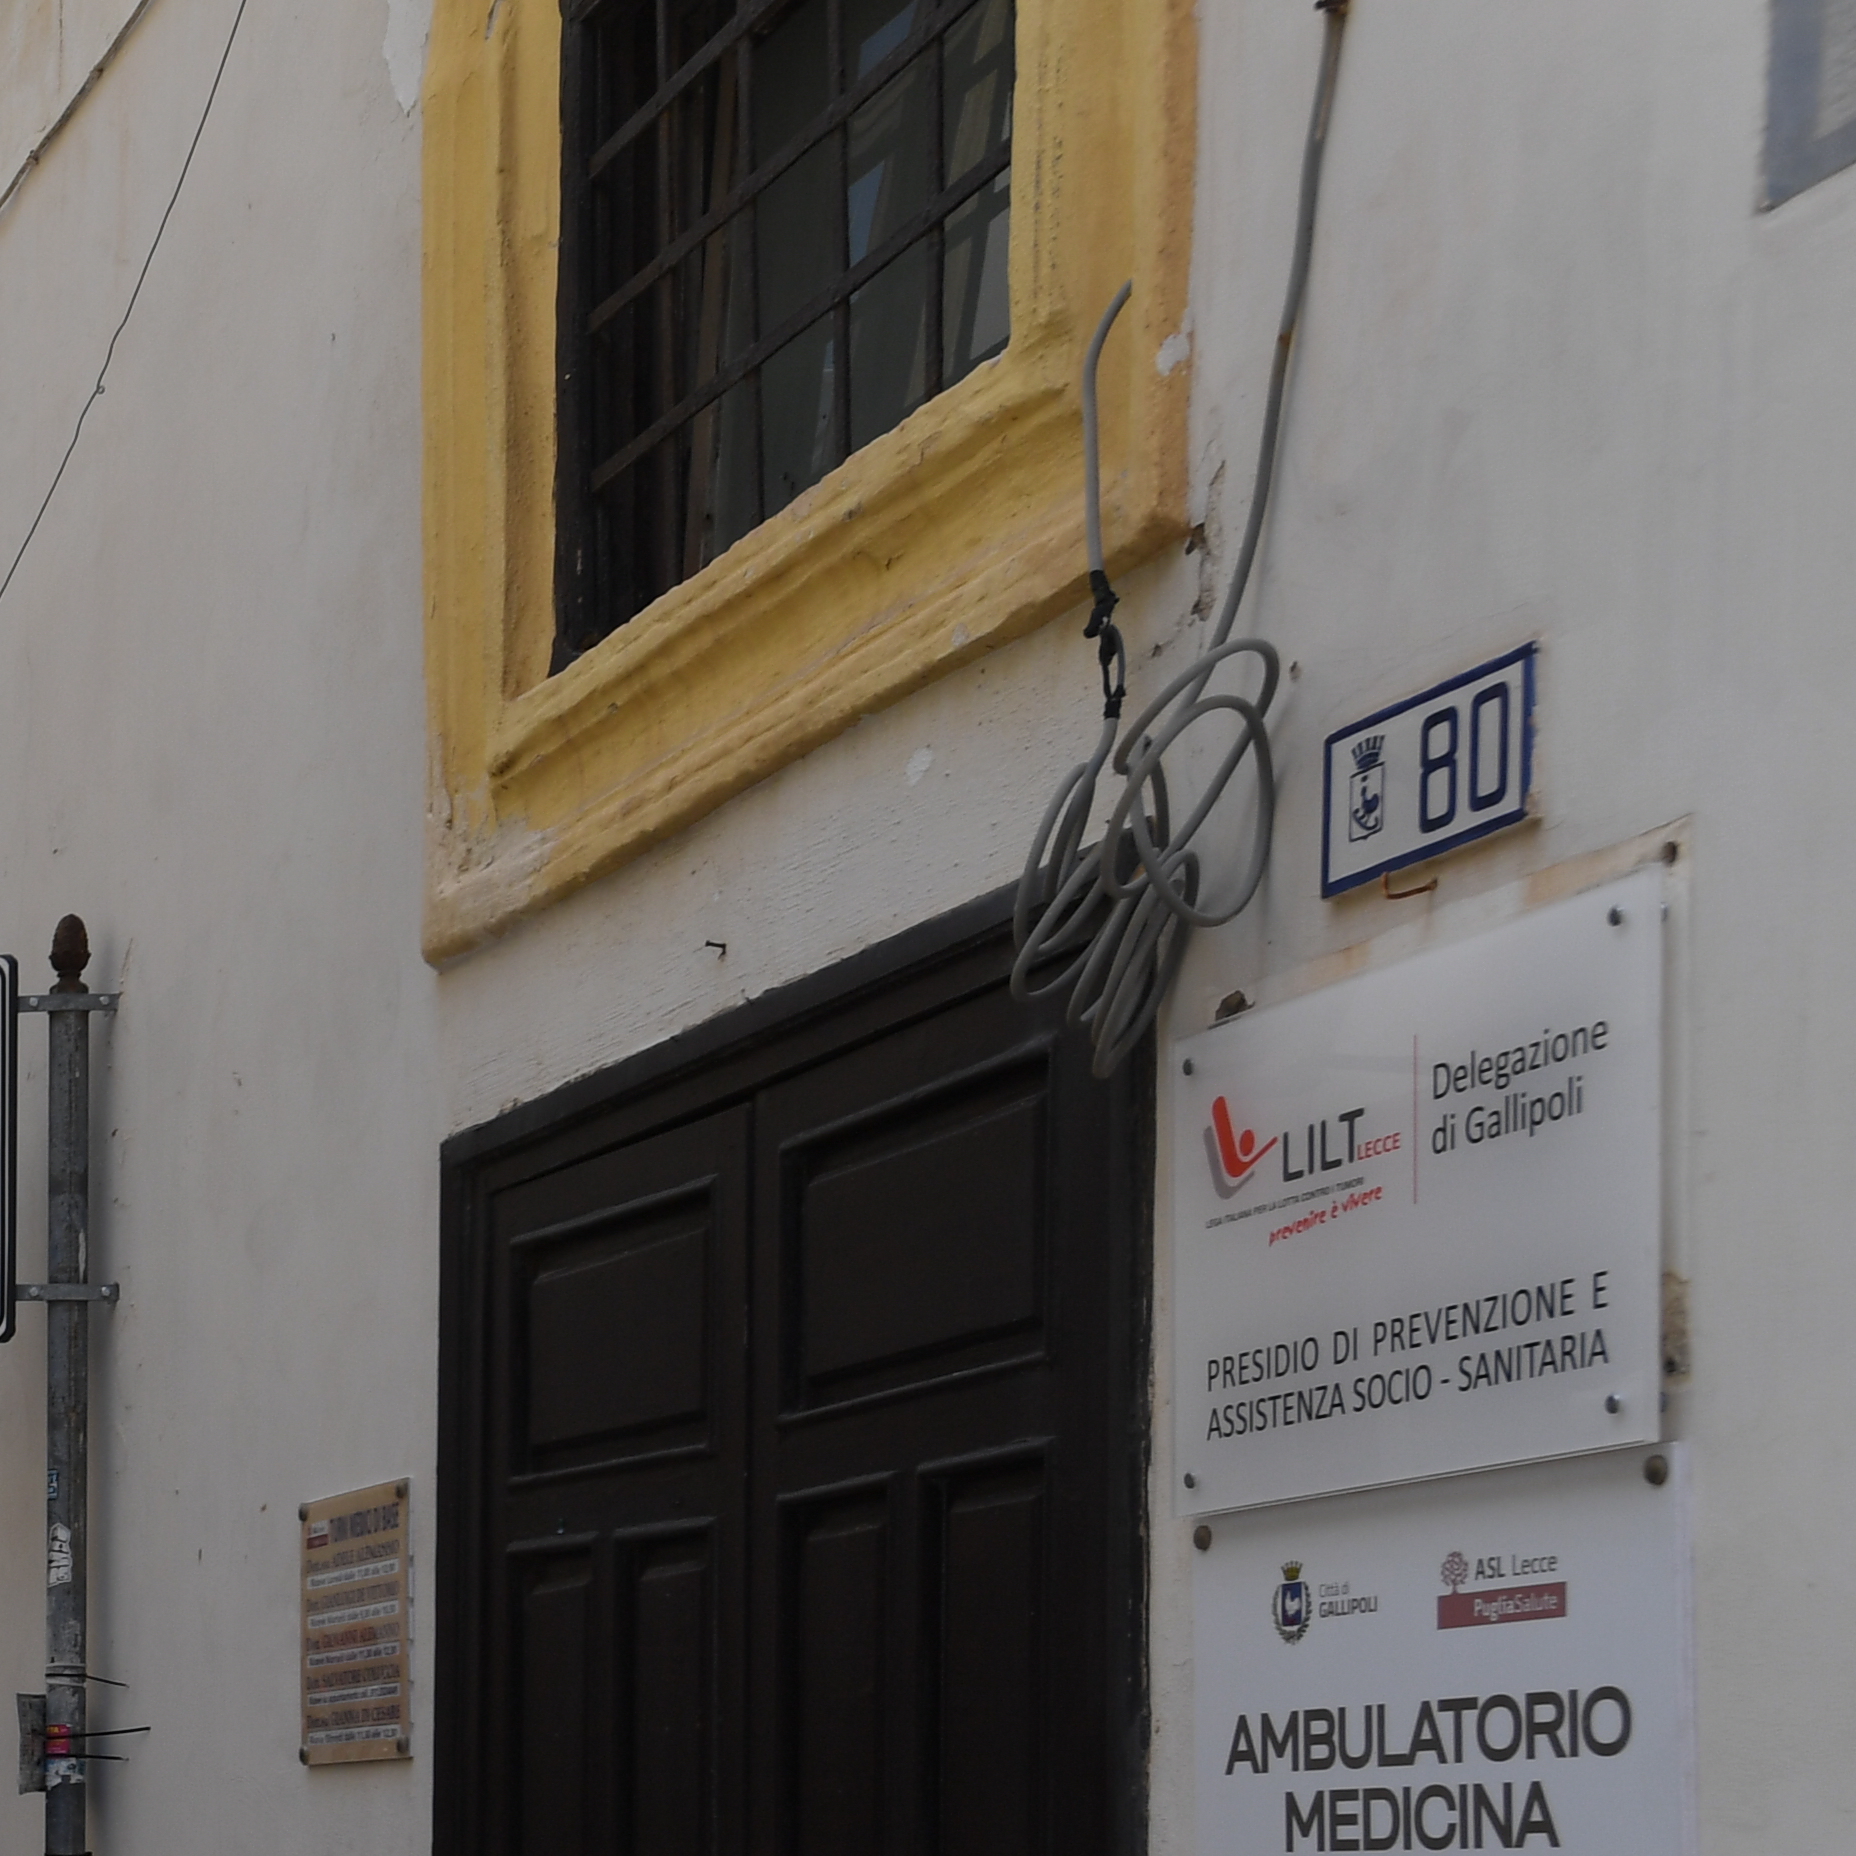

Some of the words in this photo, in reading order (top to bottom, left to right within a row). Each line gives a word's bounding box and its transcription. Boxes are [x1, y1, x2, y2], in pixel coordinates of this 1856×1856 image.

[1419, 681, 1511, 834] 80
[1432, 1019, 1609, 1101] Delegazione
[1282, 1106, 1366, 1183] LILT
[1357, 1132, 1402, 1162] LECCE
[1431, 1112, 1456, 1155] di
[1464, 1076, 1584, 1145] Gallipoli
[1269, 1210, 1326, 1248] prevenire
[1341, 1186, 1384, 1212] vivere
[1207, 1336, 1320, 1392] PRESIDIO
[1332, 1327, 1359, 1366] DI
[1373, 1277, 1576, 1357] PREVENZIONE
[1593, 1270, 1609, 1310] E
[1206, 1382, 1346, 1441] ASSISTENZA
[1352, 1364, 1433, 1413] SOCIO
[1457, 1328, 1610, 1392] SANITARIA
[1474, 1556, 1506, 1580] ASL
[1511, 1554, 1559, 1577] Lecce
[1319, 1595, 1379, 1619] GALLIPOLI
[1472, 1592, 1558, 1622] PugliaSalute
[1224, 1685, 1633, 1775] AMBULATORIO
[1284, 1780, 1561, 1853] MEDICINA
